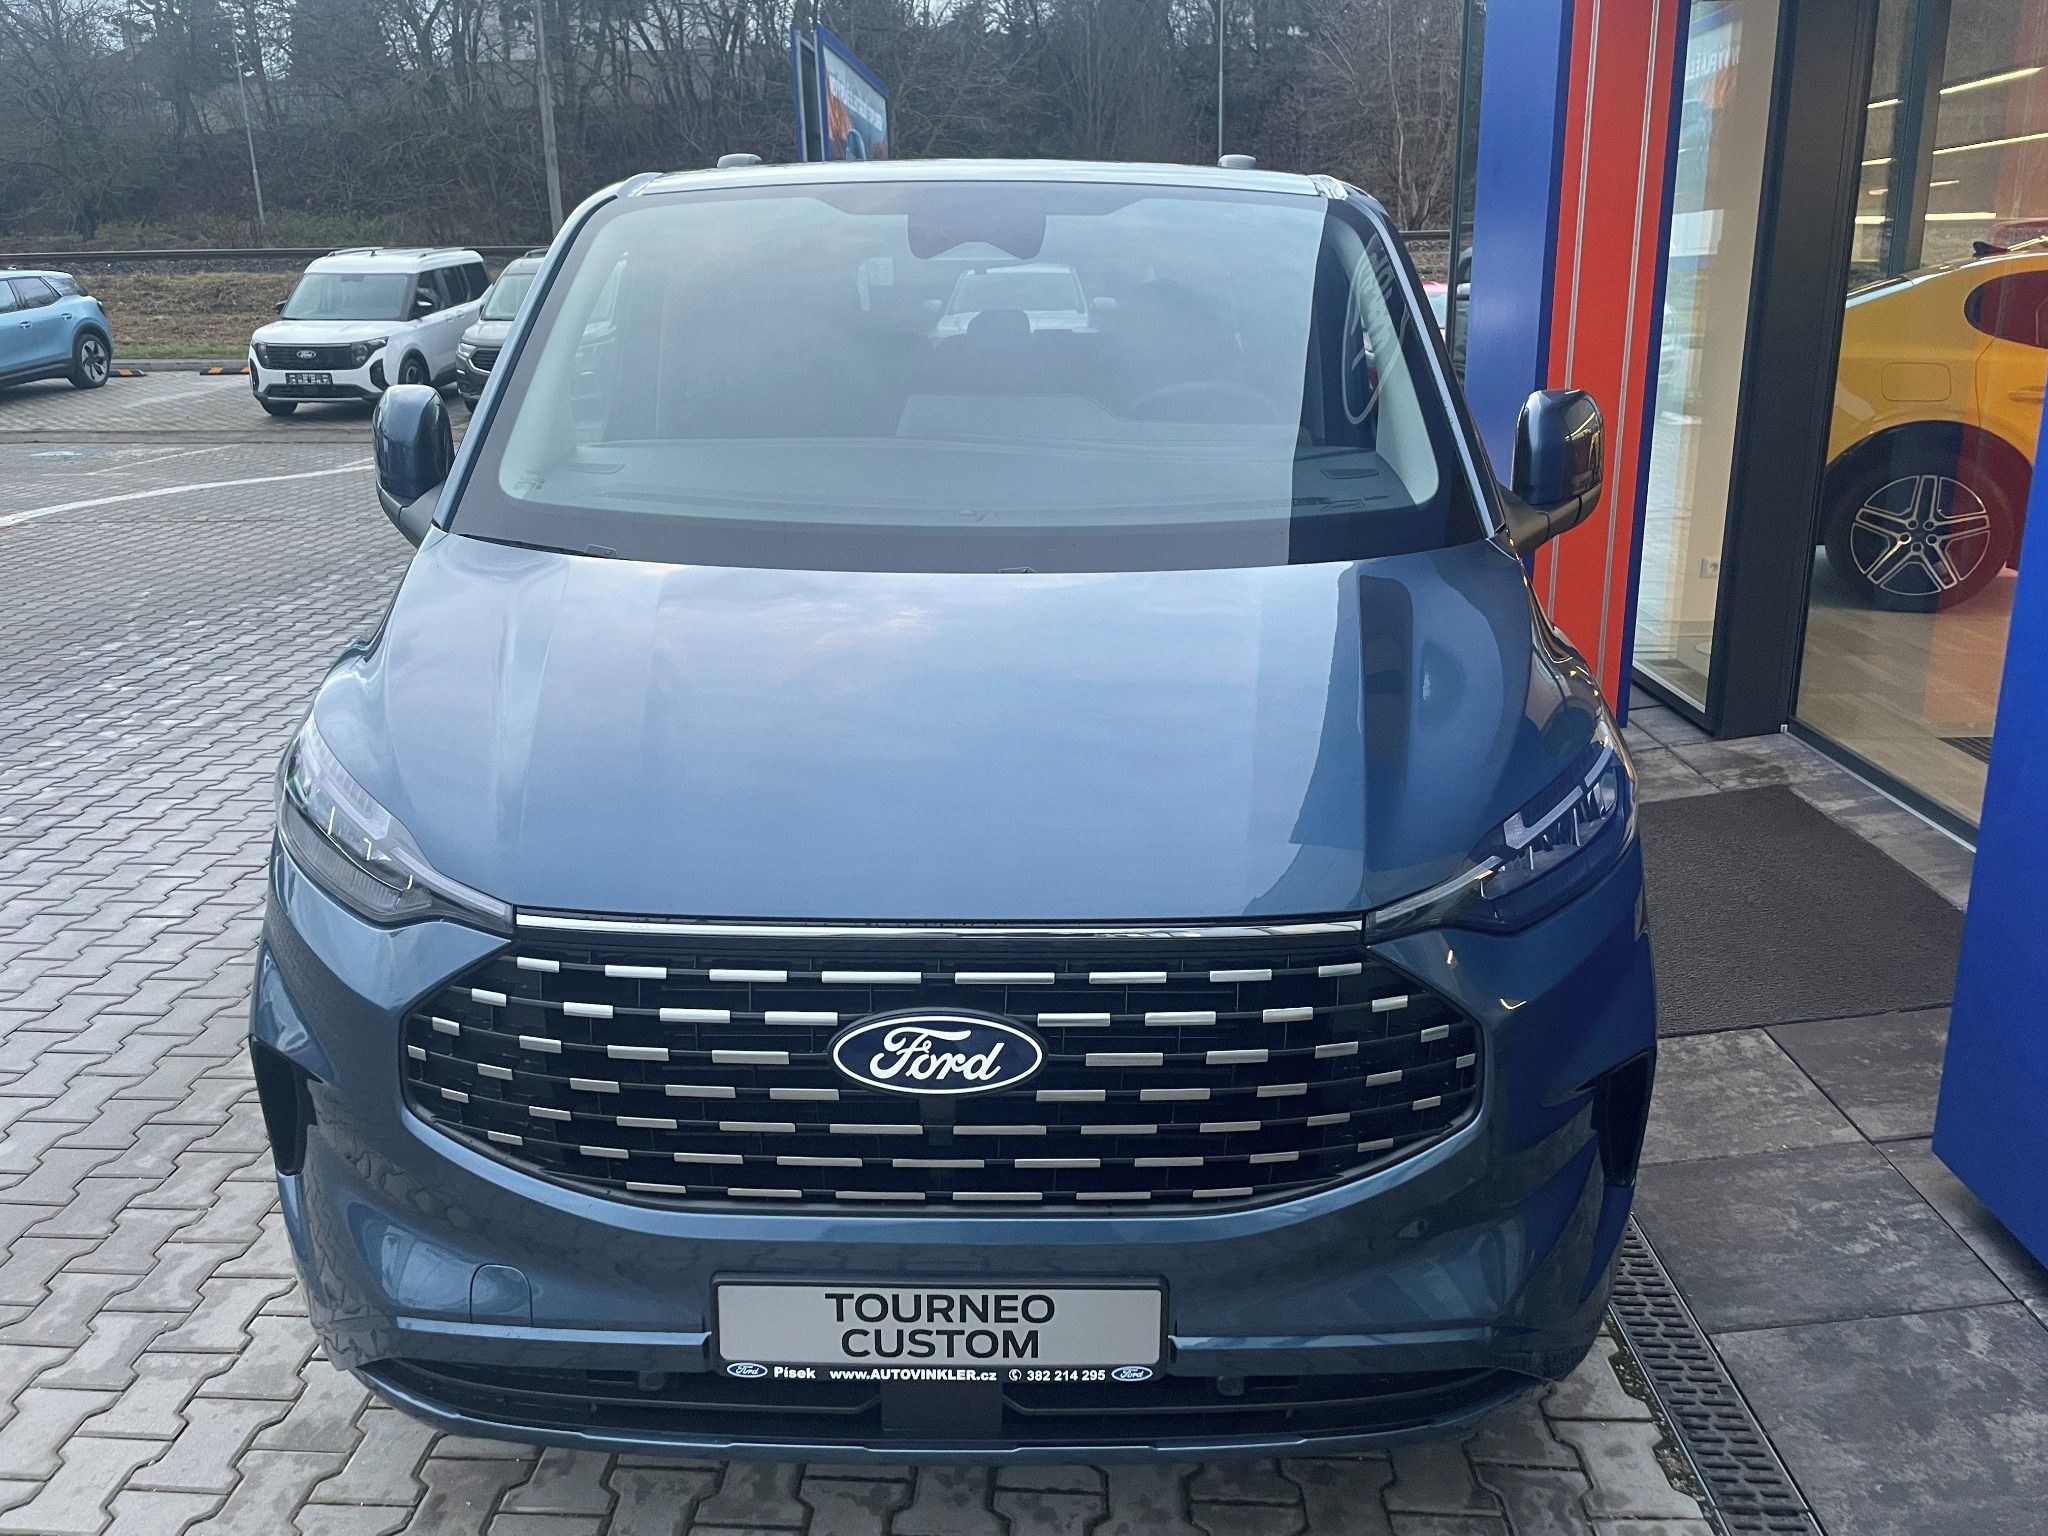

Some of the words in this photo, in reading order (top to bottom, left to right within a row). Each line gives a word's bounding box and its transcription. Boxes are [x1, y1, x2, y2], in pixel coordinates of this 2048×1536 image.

[870, 1027, 1004, 1080] Ford
[825, 1293, 1055, 1323] TOURNEO
[841, 1329, 1039, 1358] CUSTOM
[774, 1366, 816, 1379] Písek
[829, 1369, 997, 1381] www.AUTOVINKLER.cz
[1027, 1370, 1051, 1381] 382
[1054, 1370, 1078, 1381] 214
[1082, 1370, 1106, 1381] 295
